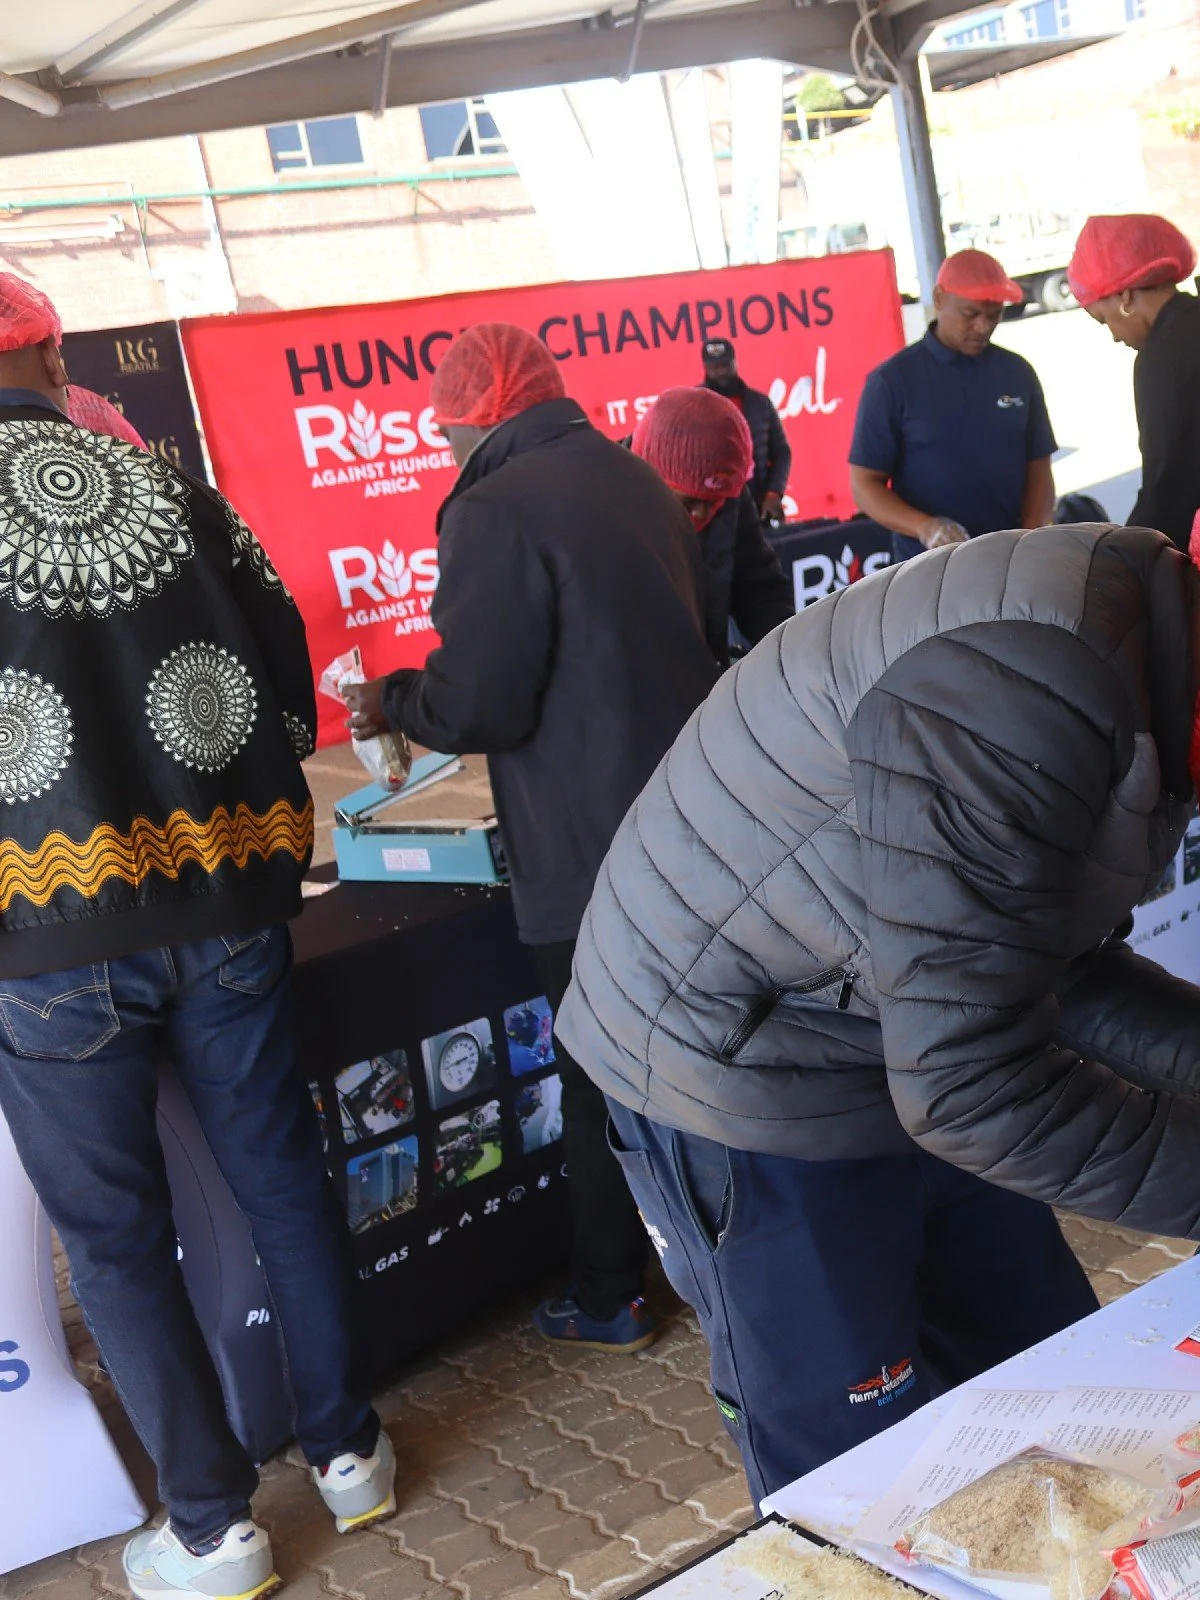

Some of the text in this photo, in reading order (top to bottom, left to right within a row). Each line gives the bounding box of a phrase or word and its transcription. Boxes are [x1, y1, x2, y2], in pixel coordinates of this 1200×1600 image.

[537, 286, 834, 361] CHAMPIONS
[115, 337, 158, 365] RG
[607, 401, 628, 426] IT
[311, 461, 386, 489] AGAINST
[364, 475, 421, 499] AFRICA
[346, 599, 417, 630] AGAINST
[375, 1246, 409, 1273] GAS
[848, 1389, 879, 1405] flame
